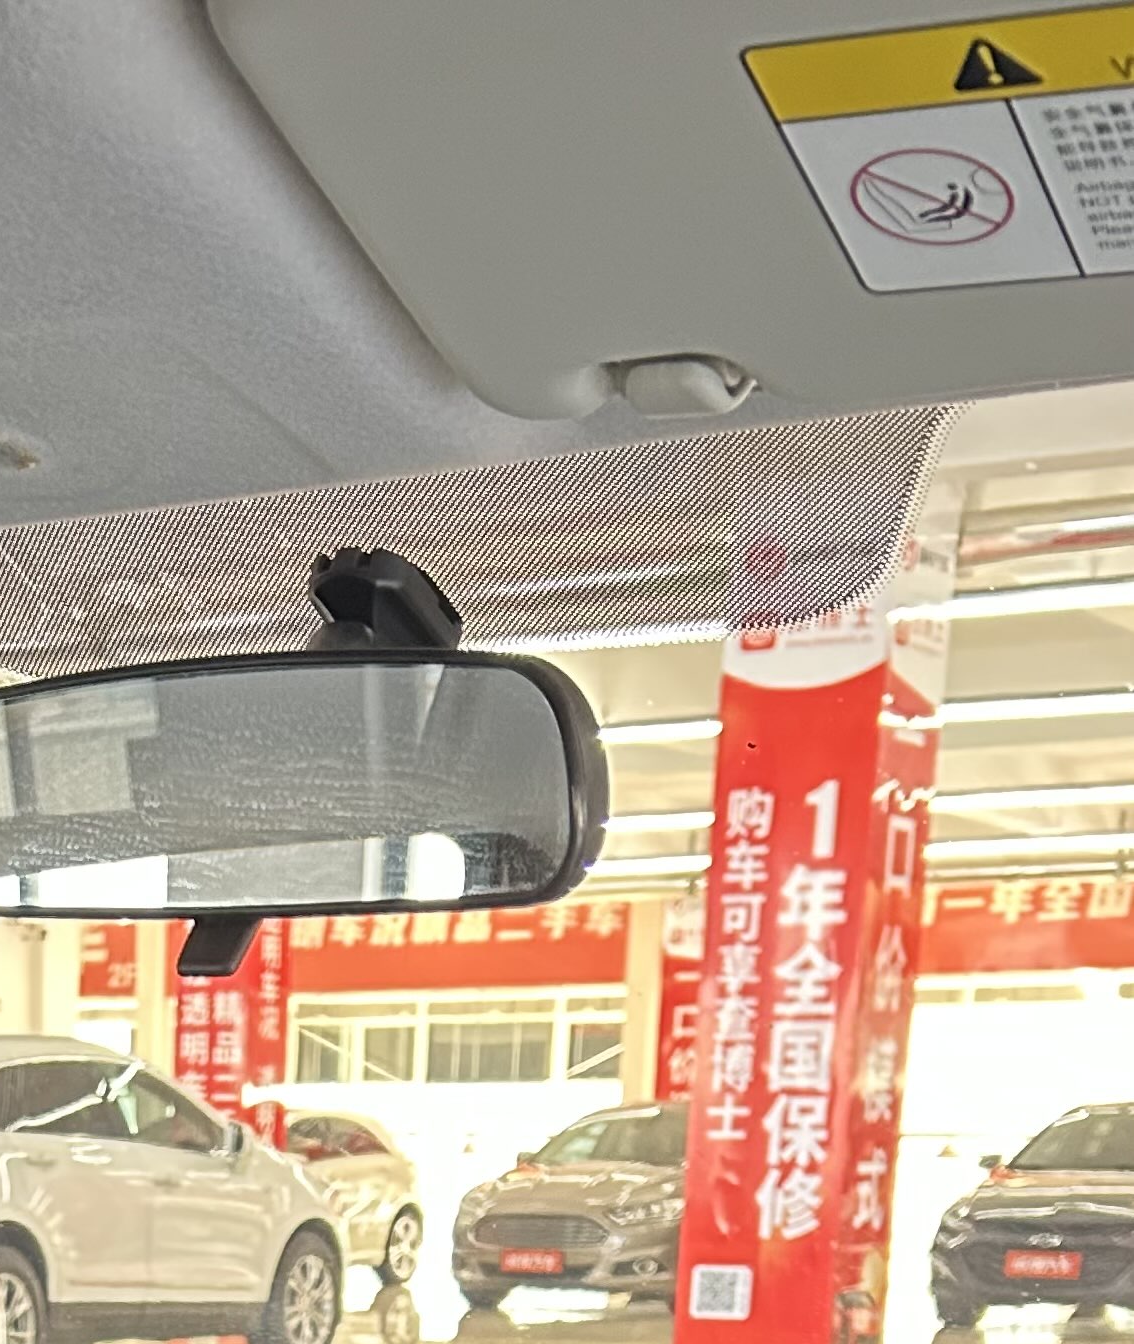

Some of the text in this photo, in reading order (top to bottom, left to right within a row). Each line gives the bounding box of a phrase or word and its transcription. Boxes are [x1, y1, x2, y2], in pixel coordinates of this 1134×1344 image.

[705, 785, 776, 1141] 购车可享查博士
